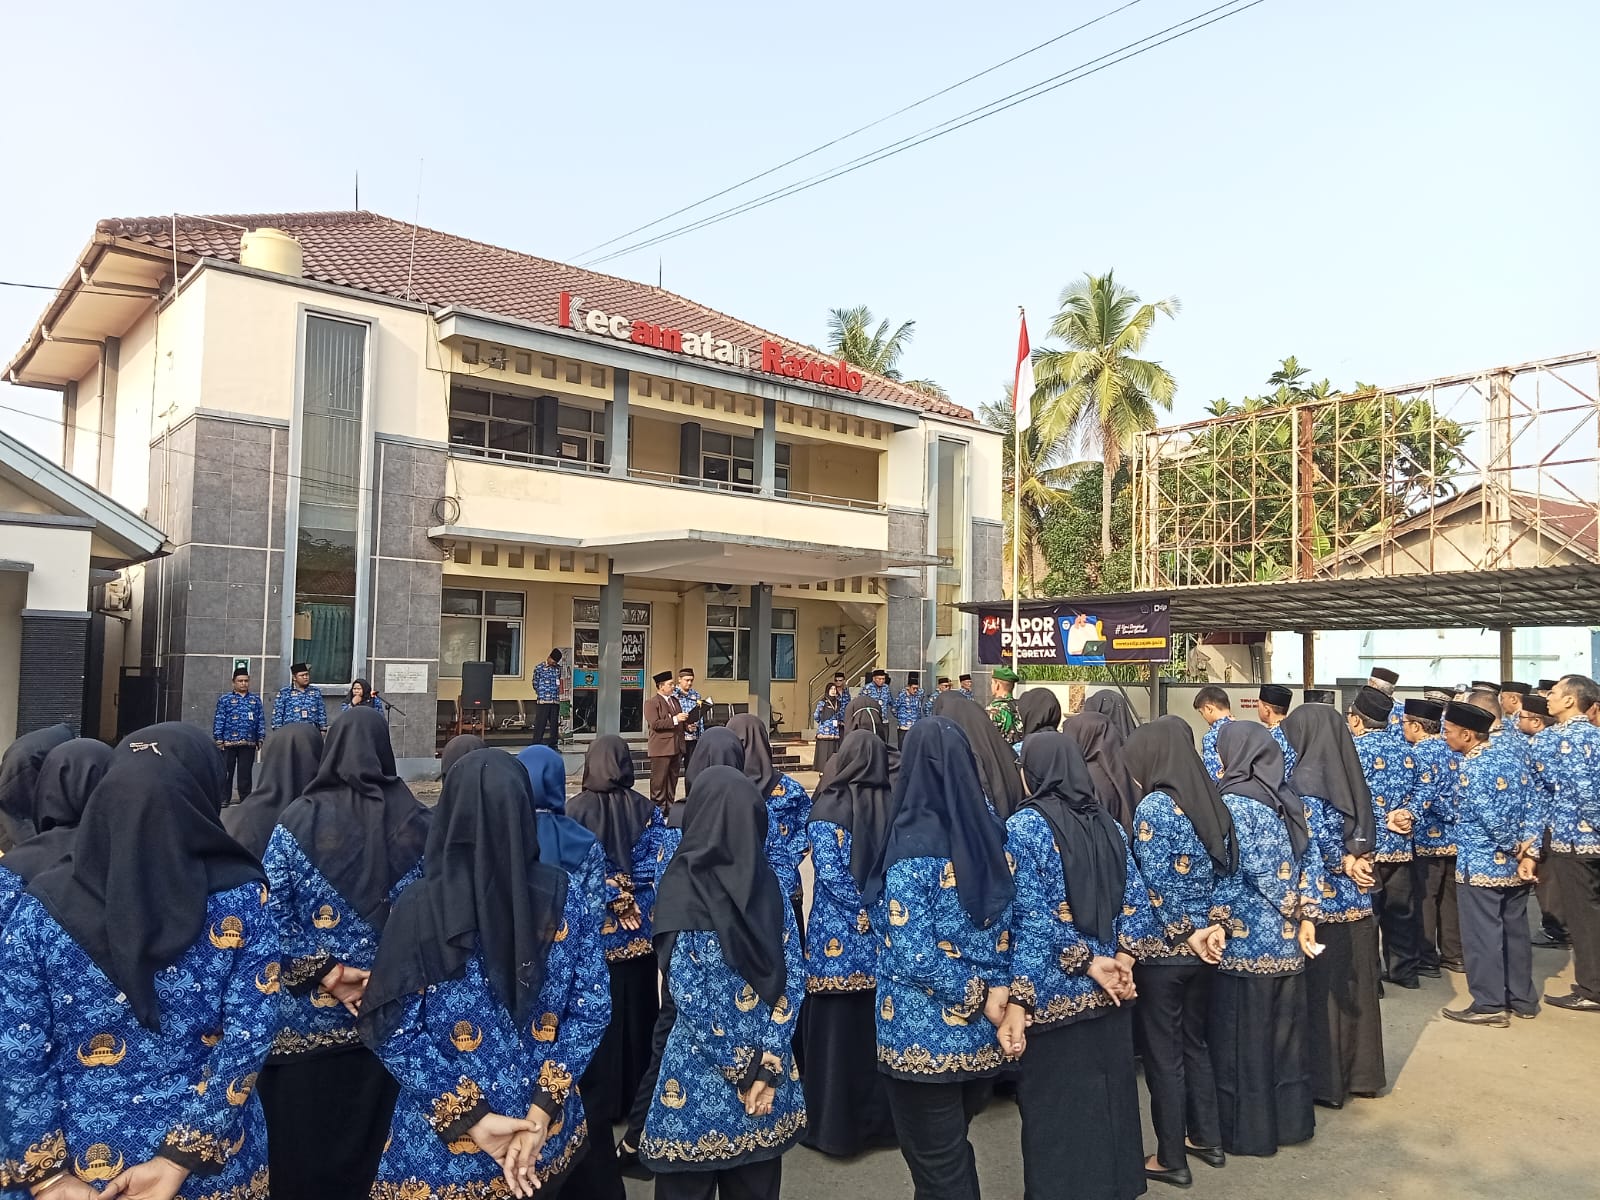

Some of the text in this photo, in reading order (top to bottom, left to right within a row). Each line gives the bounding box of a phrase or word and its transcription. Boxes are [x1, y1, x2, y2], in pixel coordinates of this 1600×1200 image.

[559, 291, 863, 393] Kecamatan Rawalo
[1001, 617, 1055, 632] LAPOR
[1001, 632, 1056, 647] PAJAK
[1017, 649, 1057, 658] CORETAX
